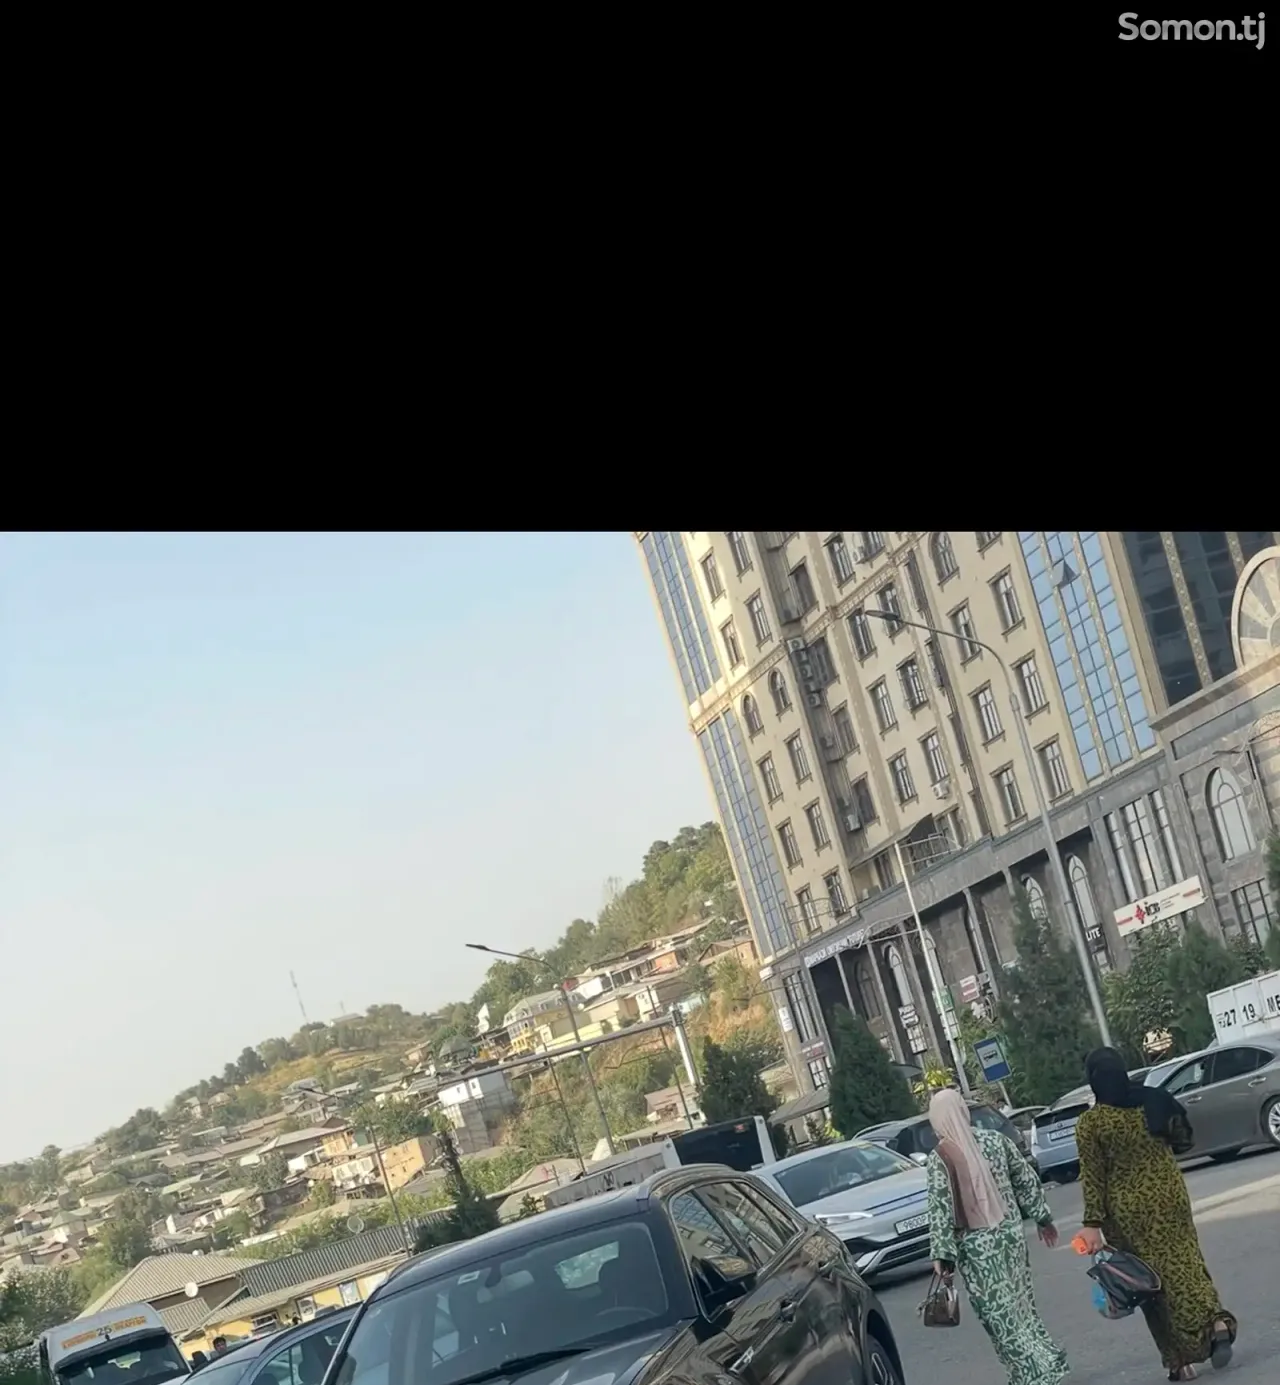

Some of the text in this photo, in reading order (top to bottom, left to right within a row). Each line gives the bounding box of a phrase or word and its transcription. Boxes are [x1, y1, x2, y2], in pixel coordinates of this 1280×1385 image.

[1224, 1008, 1237, 1027] 27
[1242, 1003, 1256, 1021] 19
[96, 1325, 112, 1336] 25
